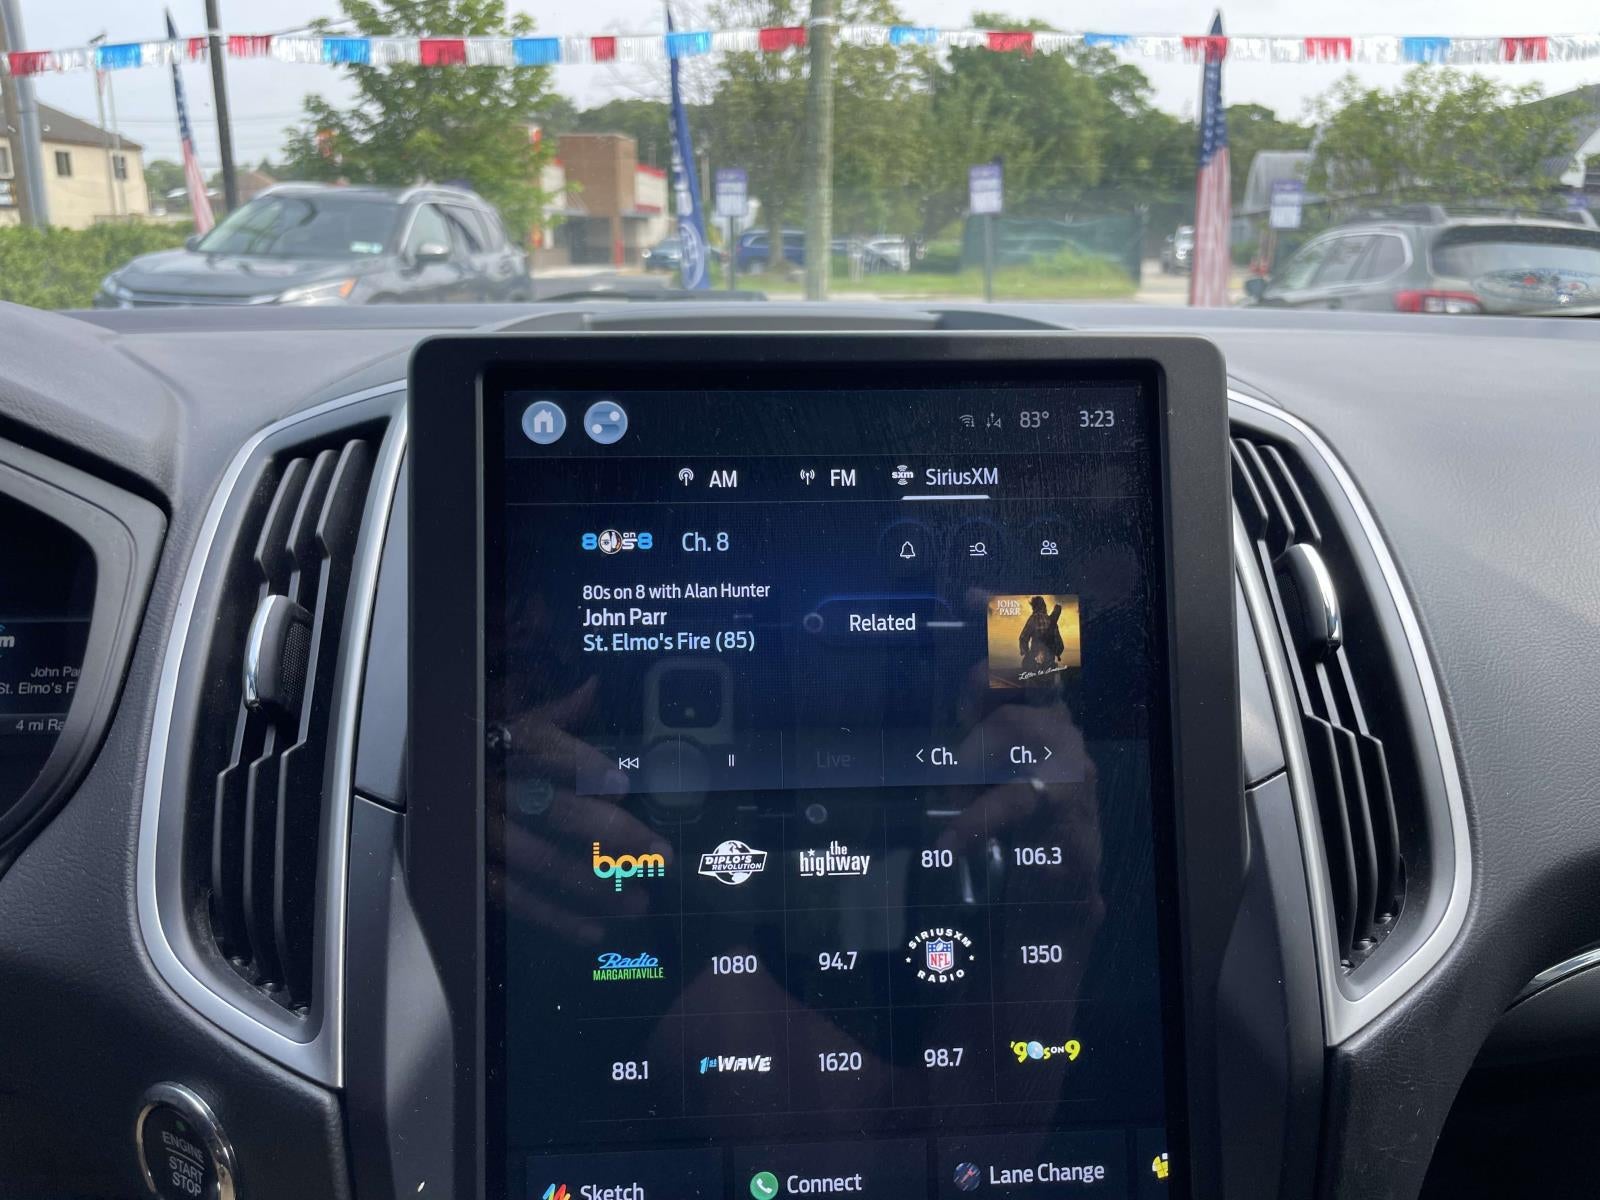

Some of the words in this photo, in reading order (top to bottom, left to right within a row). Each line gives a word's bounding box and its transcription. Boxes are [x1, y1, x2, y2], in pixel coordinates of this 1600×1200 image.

[1019, 411, 1050, 428] 83°
[1079, 410, 1116, 427] 3:23
[709, 471, 738, 488] AM
[830, 470, 856, 487] FM
[925, 467, 999, 486] SiriusXM
[681, 532, 712, 552] Ch.
[716, 532, 729, 551] 8
[582, 585, 611, 600] 80s
[613, 586, 632, 600] on
[635, 584, 646, 599] 8
[649, 584, 681, 599] with
[684, 583, 718, 598] Alan
[720, 583, 771, 598] Hunter
[997, 600, 1020, 610] JOHN
[582, 608, 626, 627] John
[629, 608, 668, 626] Parr
[849, 612, 916, 632] Related
[583, 633, 608, 651] St.
[612, 632, 674, 651] Elmo's
[677, 632, 711, 650] Fire
[715, 630, 755, 652] (85)
[31, 666, 60, 678] John
[0, 682, 14, 695] St.
[18, 681, 63, 695] Elmo's
[16, 719, 24, 731] 4
[28, 719, 44, 731] mi
[816, 752, 850, 769] Live
[930, 747, 958, 765] Ch.
[1009, 746, 1037, 764] Ch.
[830, 841, 848, 855] the
[1014, 847, 1062, 866] 106.3
[592, 841, 665, 892] bpm
[704, 855, 753, 864] DIPLO'S
[711, 861, 763, 871] REVOLUTION
[799, 848, 871, 877] highway
[921, 849, 953, 868] 810
[908, 927, 972, 950] SIRIUSXM
[597, 952, 659, 969] Radio
[818, 951, 858, 971] 94.7
[930, 952, 951, 968] NFL
[1020, 945, 1063, 964] 1350
[593, 967, 664, 981] MARGARITAVILLE
[711, 955, 757, 975] 1080
[917, 969, 965, 983] RADIO
[924, 1047, 964, 1068] 98.7
[1064, 1039, 1081, 1061] 9
[612, 1060, 649, 1081] 88.1
[717, 1055, 772, 1073] WAVE
[817, 1051, 862, 1072] 1620
[162, 1131, 204, 1163] ENGINE
[168, 1155, 204, 1185] START
[990, 1165, 1034, 1185] Lane
[1037, 1163, 1105, 1183] Change
[172, 1171, 202, 1197] STOP
[580, 1182, 645, 1200] Sketch
[787, 1173, 863, 1194] Connect
